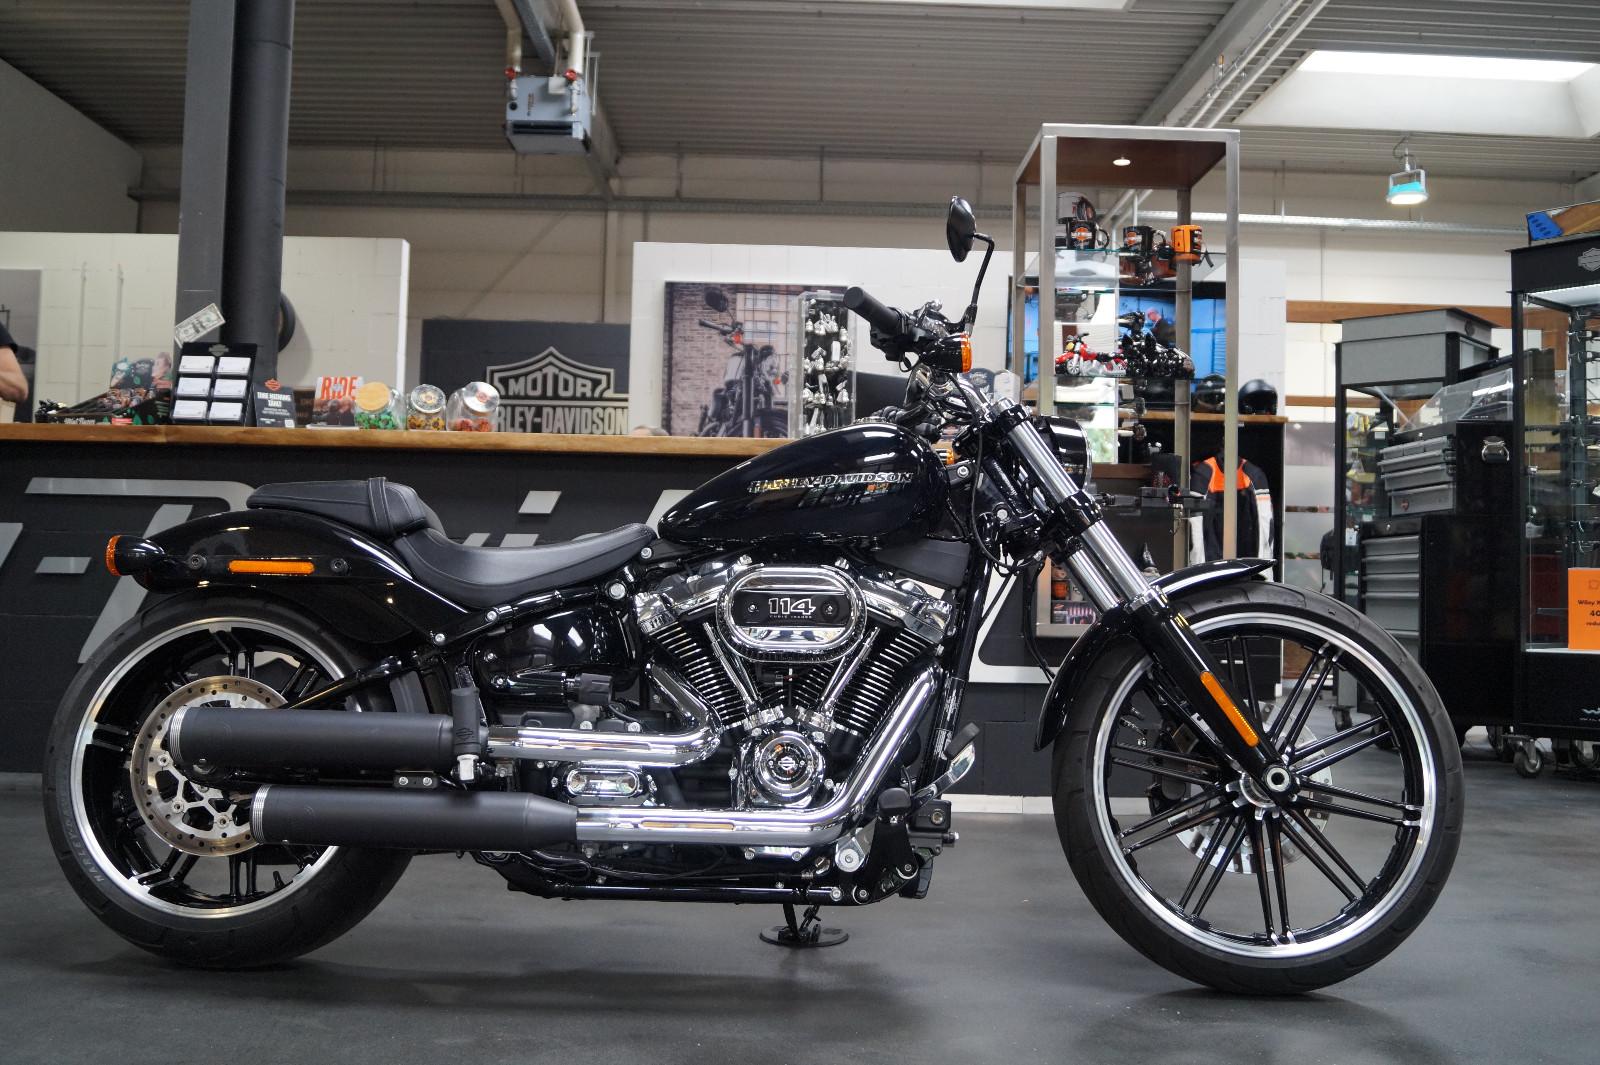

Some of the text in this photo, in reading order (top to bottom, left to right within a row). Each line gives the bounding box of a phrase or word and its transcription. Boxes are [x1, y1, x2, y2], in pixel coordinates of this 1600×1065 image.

[320, 375, 358, 401] RIDE
[508, 364, 592, 398] MOTOR
[497, 406, 628, 435] RLEY-DAVIDSON
[748, 471, 914, 493] HARLEY-DAVIDSON
[768, 597, 816, 615] 114
